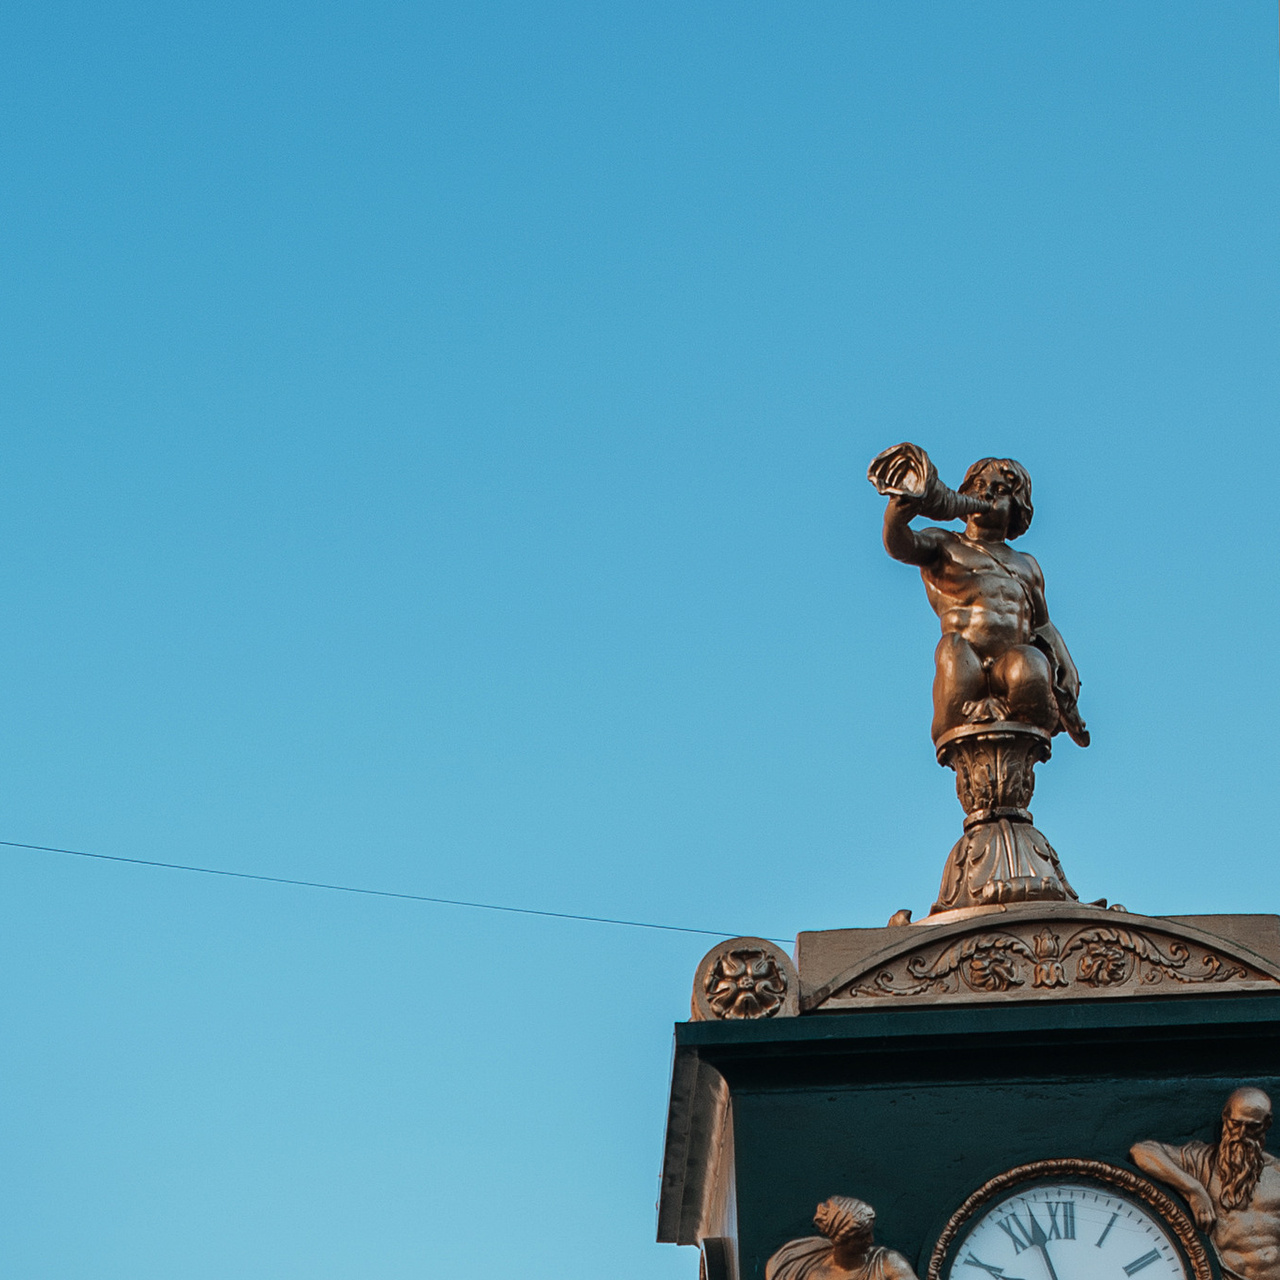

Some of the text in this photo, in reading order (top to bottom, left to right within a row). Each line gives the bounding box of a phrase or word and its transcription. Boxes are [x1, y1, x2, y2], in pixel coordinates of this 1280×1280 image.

[1046, 1201, 1076, 1240] XII
[1095, 1213, 1119, 1248] I
[963, 1252, 1004, 1280] X
[1122, 1248, 1162, 1277] II
